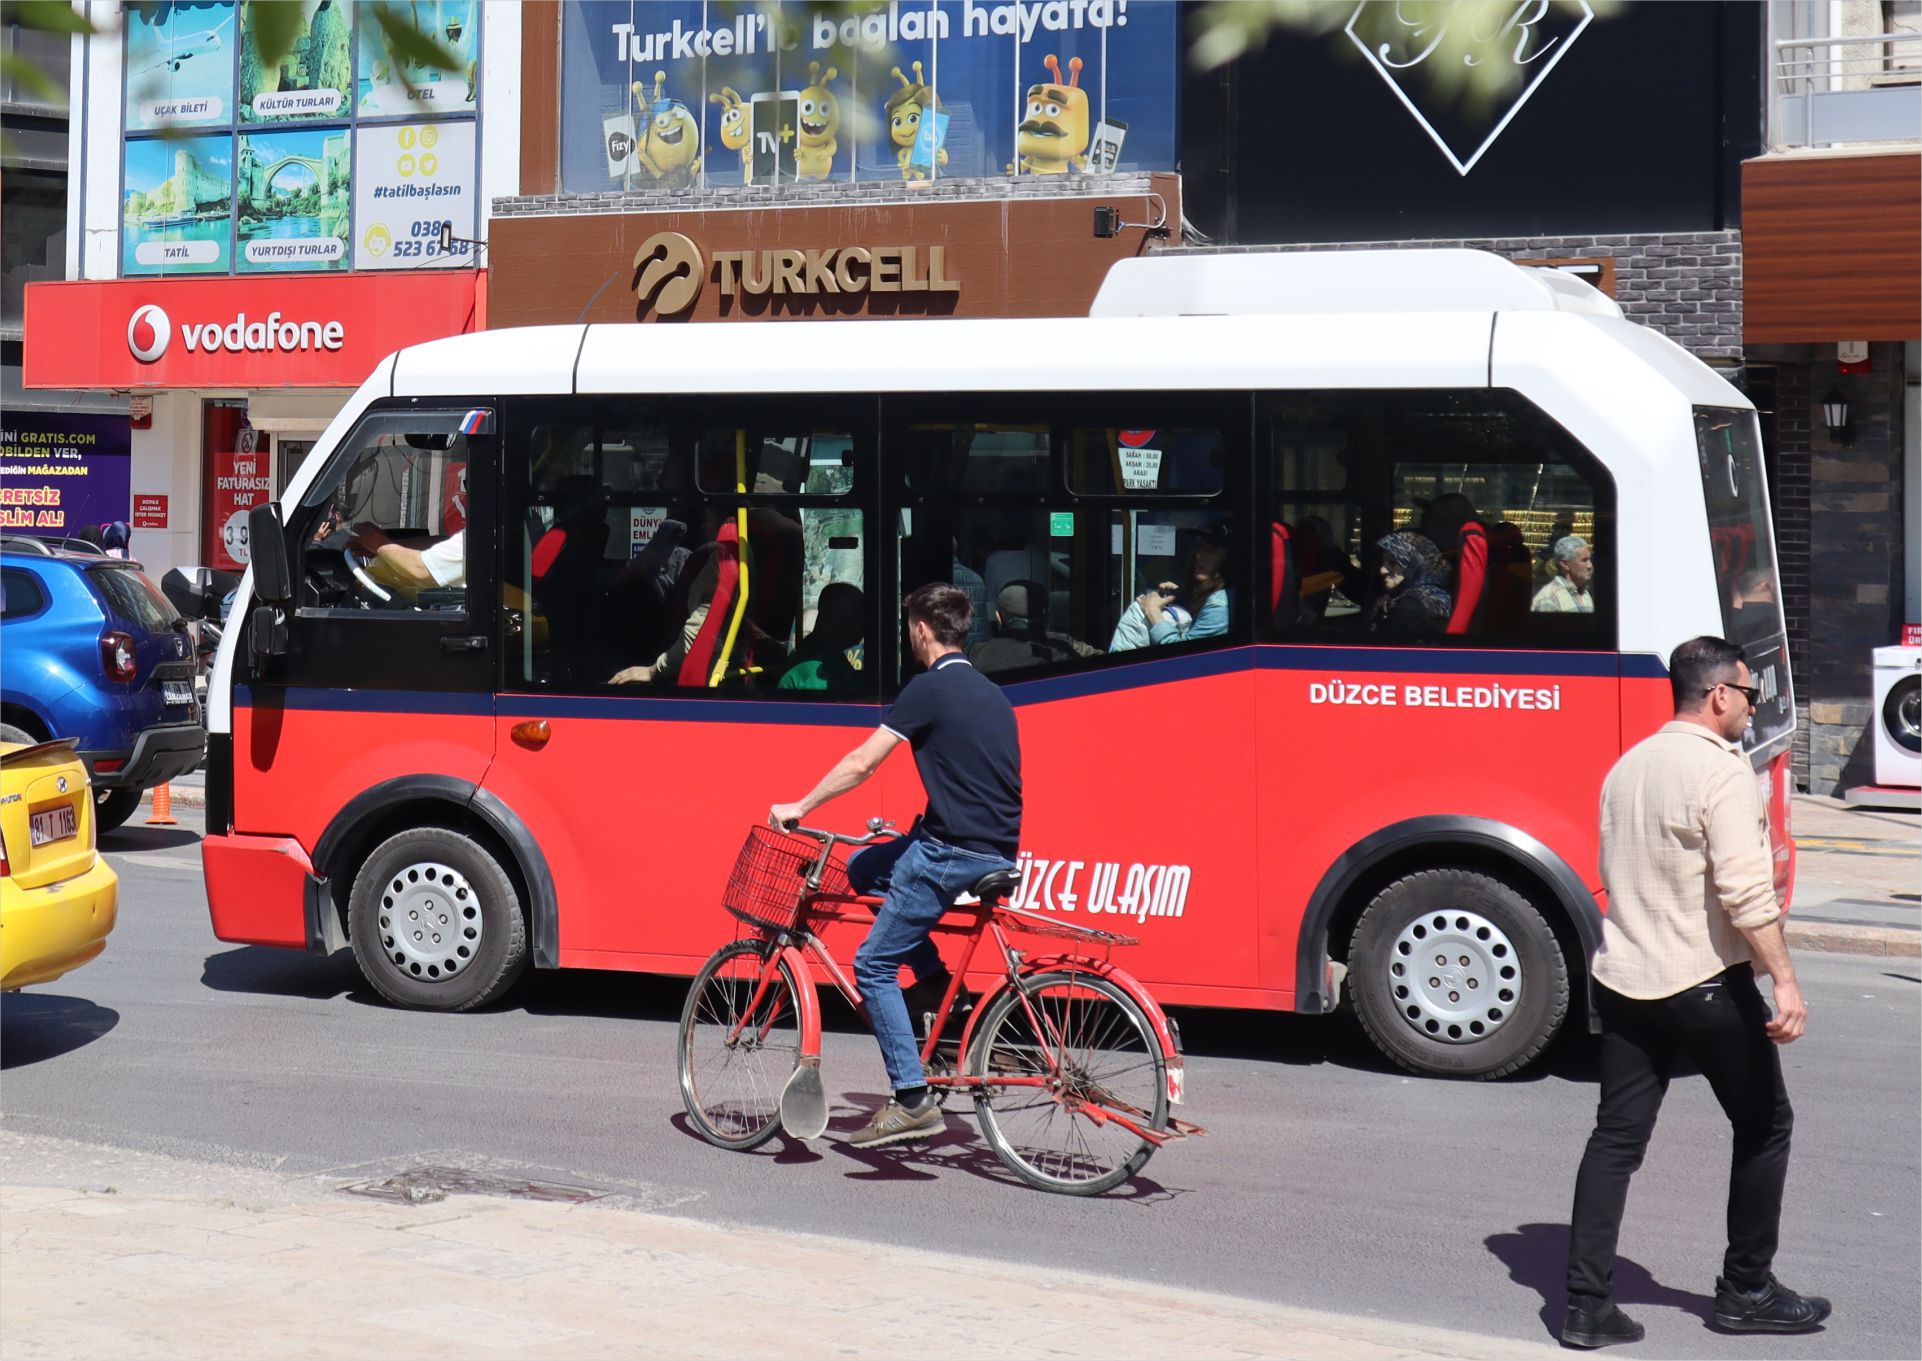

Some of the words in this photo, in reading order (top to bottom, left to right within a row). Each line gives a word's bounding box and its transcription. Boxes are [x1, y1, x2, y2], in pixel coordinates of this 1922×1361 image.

[407, 89, 435, 100] OTEL
[154, 105, 177, 118] UÇAK
[180, 103, 208, 114] BİLETİ
[259, 98, 294, 110] KÜLTÜR
[296, 96, 334, 108] TURLARI
[373, 182, 461, 200] #tatilbaşlasın
[164, 245, 190, 258] TATİL
[251, 244, 296, 258] YURTDIŞI
[298, 244, 338, 255] TURLAR
[393, 241, 423, 257] 523
[712, 245, 961, 295] TURKCELL
[181, 312, 344, 351] vodafone
[20, 432, 96, 444] GRATIS.COM
[53, 447, 82, 461] VER,
[27, 463, 88, 476] MAĞAZADAN
[233, 458, 256, 475] YENİ
[217, 476, 271, 491] FATURASIZ
[233, 493, 255, 506] HAT
[36, 510, 65, 527] AL!
[1309, 679, 1397, 706] DÜZCE
[1404, 683, 1560, 710] BELEDİYESİ
[35, 815, 44, 842] 81
[1008, 851, 1085, 911] ÜZCE
[1087, 861, 1192, 924] ULAŞIM
